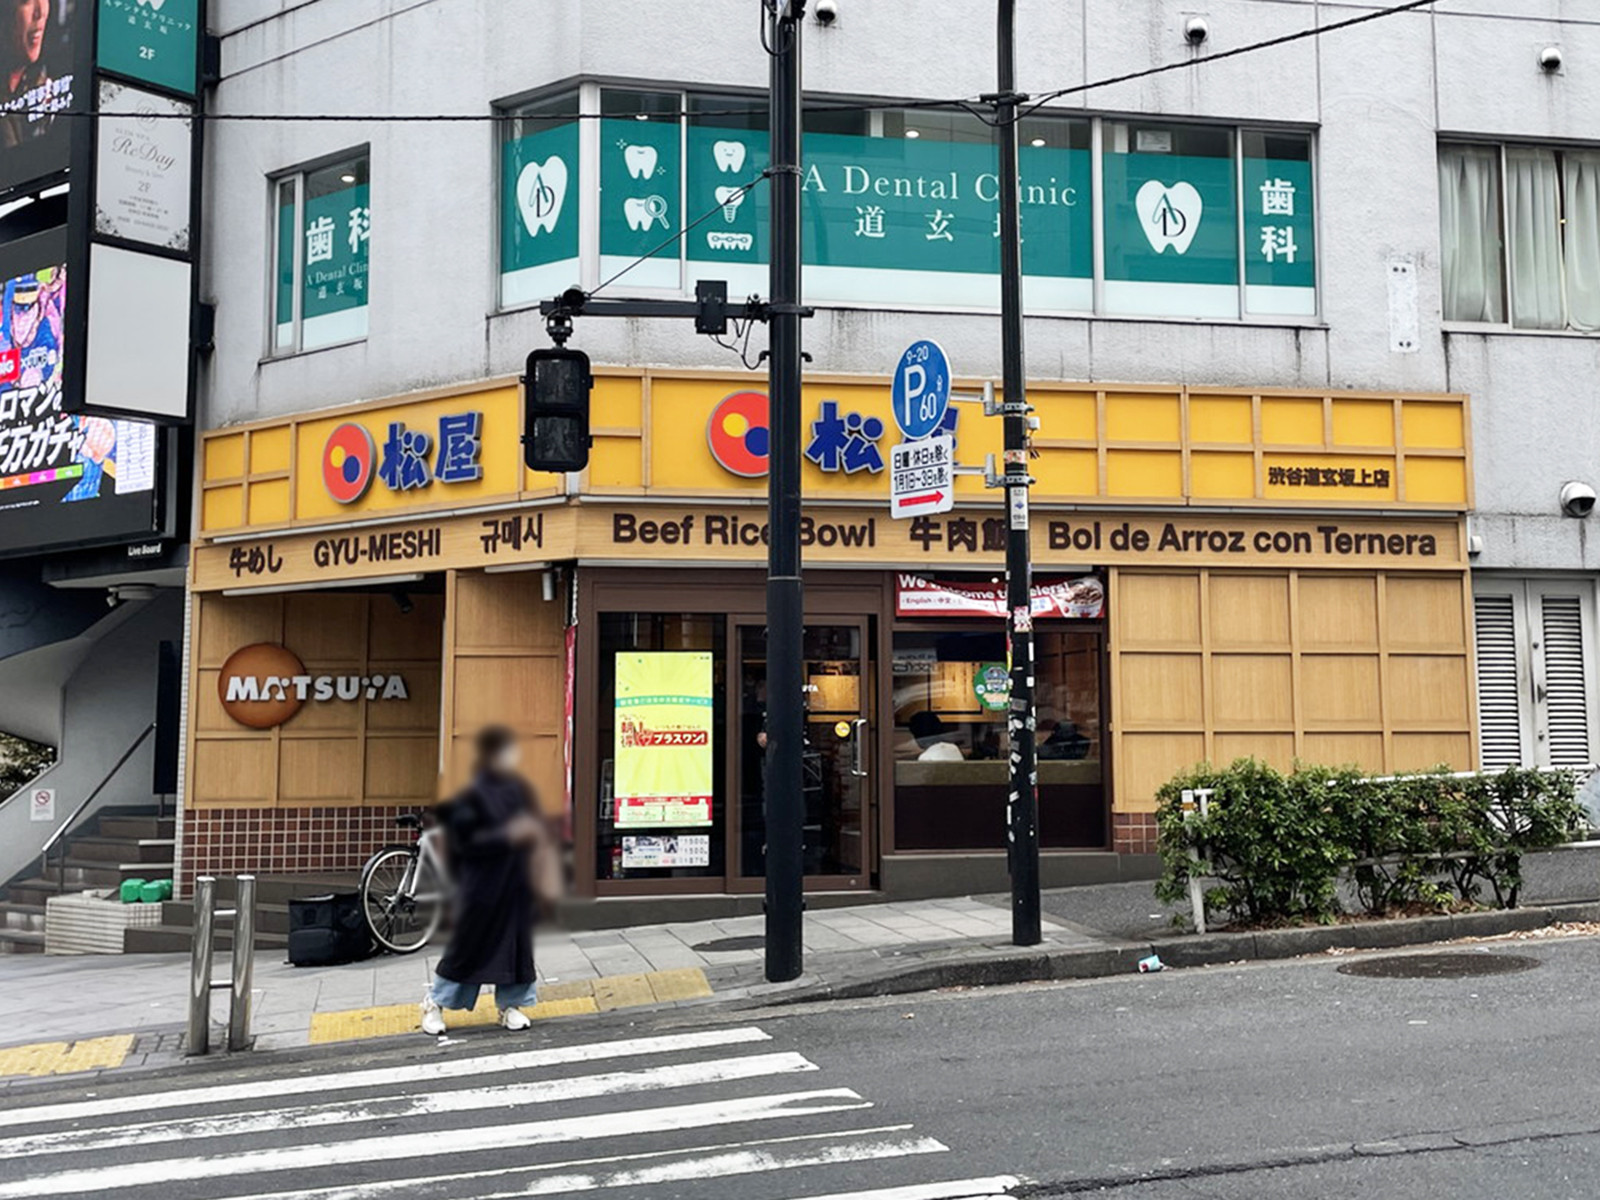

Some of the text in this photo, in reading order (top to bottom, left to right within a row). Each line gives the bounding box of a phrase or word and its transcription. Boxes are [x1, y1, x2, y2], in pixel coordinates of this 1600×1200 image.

[139, 45, 156, 60] 2F
[801, 164, 1077, 206] A Dental Cinic
[306, 207, 370, 265] 歯科
[1259, 178, 1298, 264] 歯科
[316, 265, 346, 284] Dental
[906, 345, 929, 365] 9-20
[904, 364, 926, 426] P
[919, 392, 937, 422] 60
[378, 411, 484, 491] 松屋
[1268, 466, 1390, 488] 渋谷道玄坂上店
[613, 513, 693, 544] Beef
[799, 517, 876, 547] Bowl
[1049, 521, 1436, 555] Bol de Arroz con Ternera
[229, 544, 283, 578] 牛めし
[314, 528, 441, 567] GYU-MESHI
[898, 573, 926, 589] We
[998, 581, 1070, 600] telers!
[226, 675, 408, 701] MATSUYA
